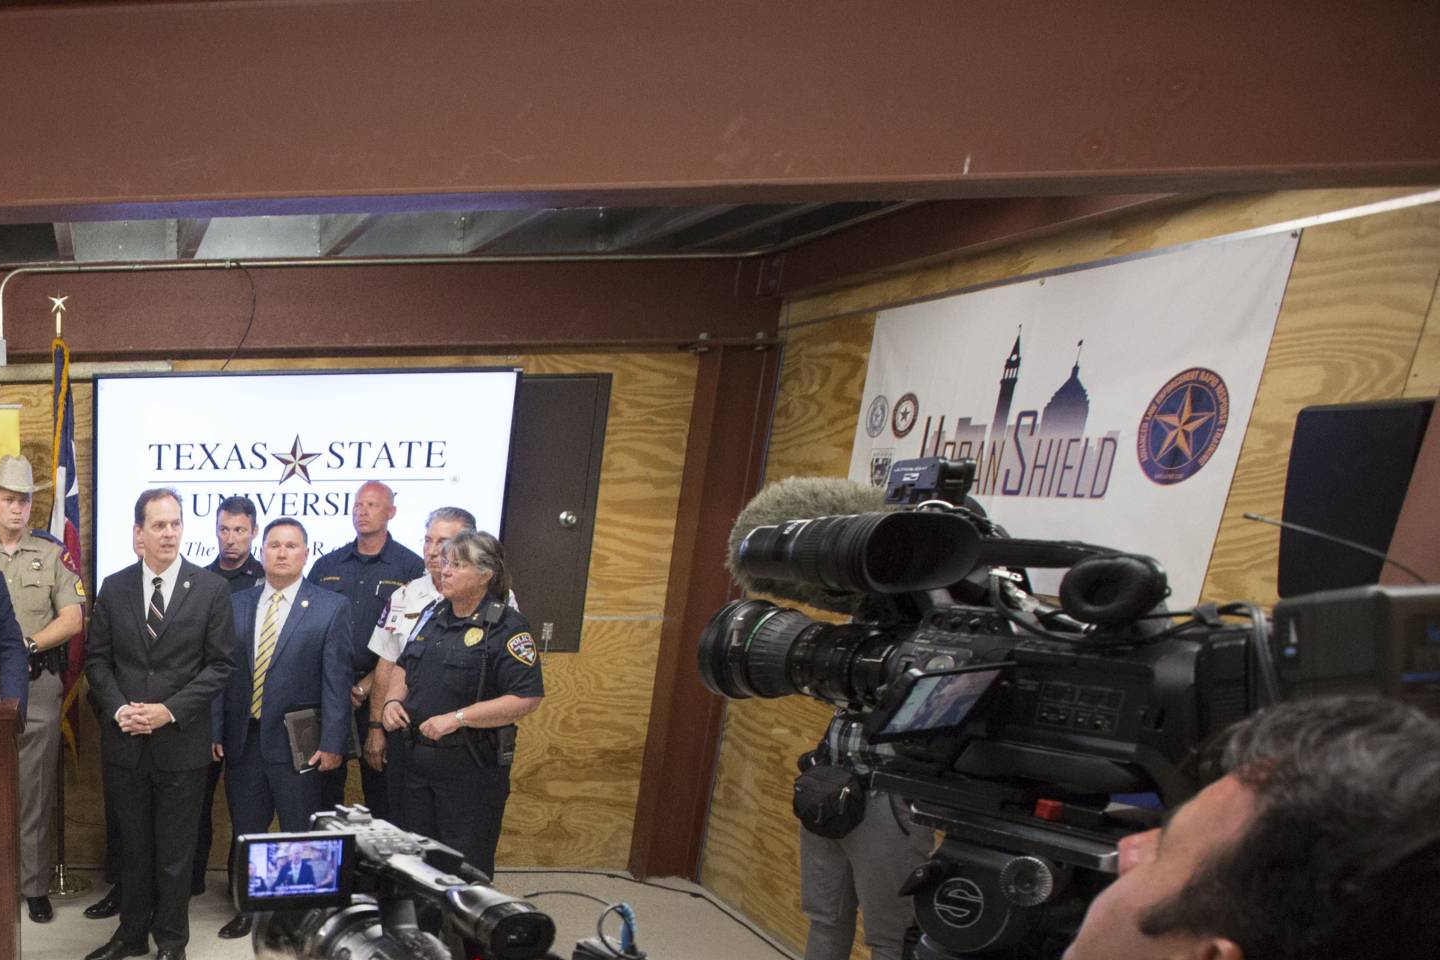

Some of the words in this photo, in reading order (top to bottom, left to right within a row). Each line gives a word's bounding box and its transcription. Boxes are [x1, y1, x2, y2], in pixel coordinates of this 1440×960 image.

[148, 441, 268, 472] TEXAS
[326, 440, 447, 470] STATE
[192, 492, 398, 517] UVERSI
[185, 541, 215, 558] The
